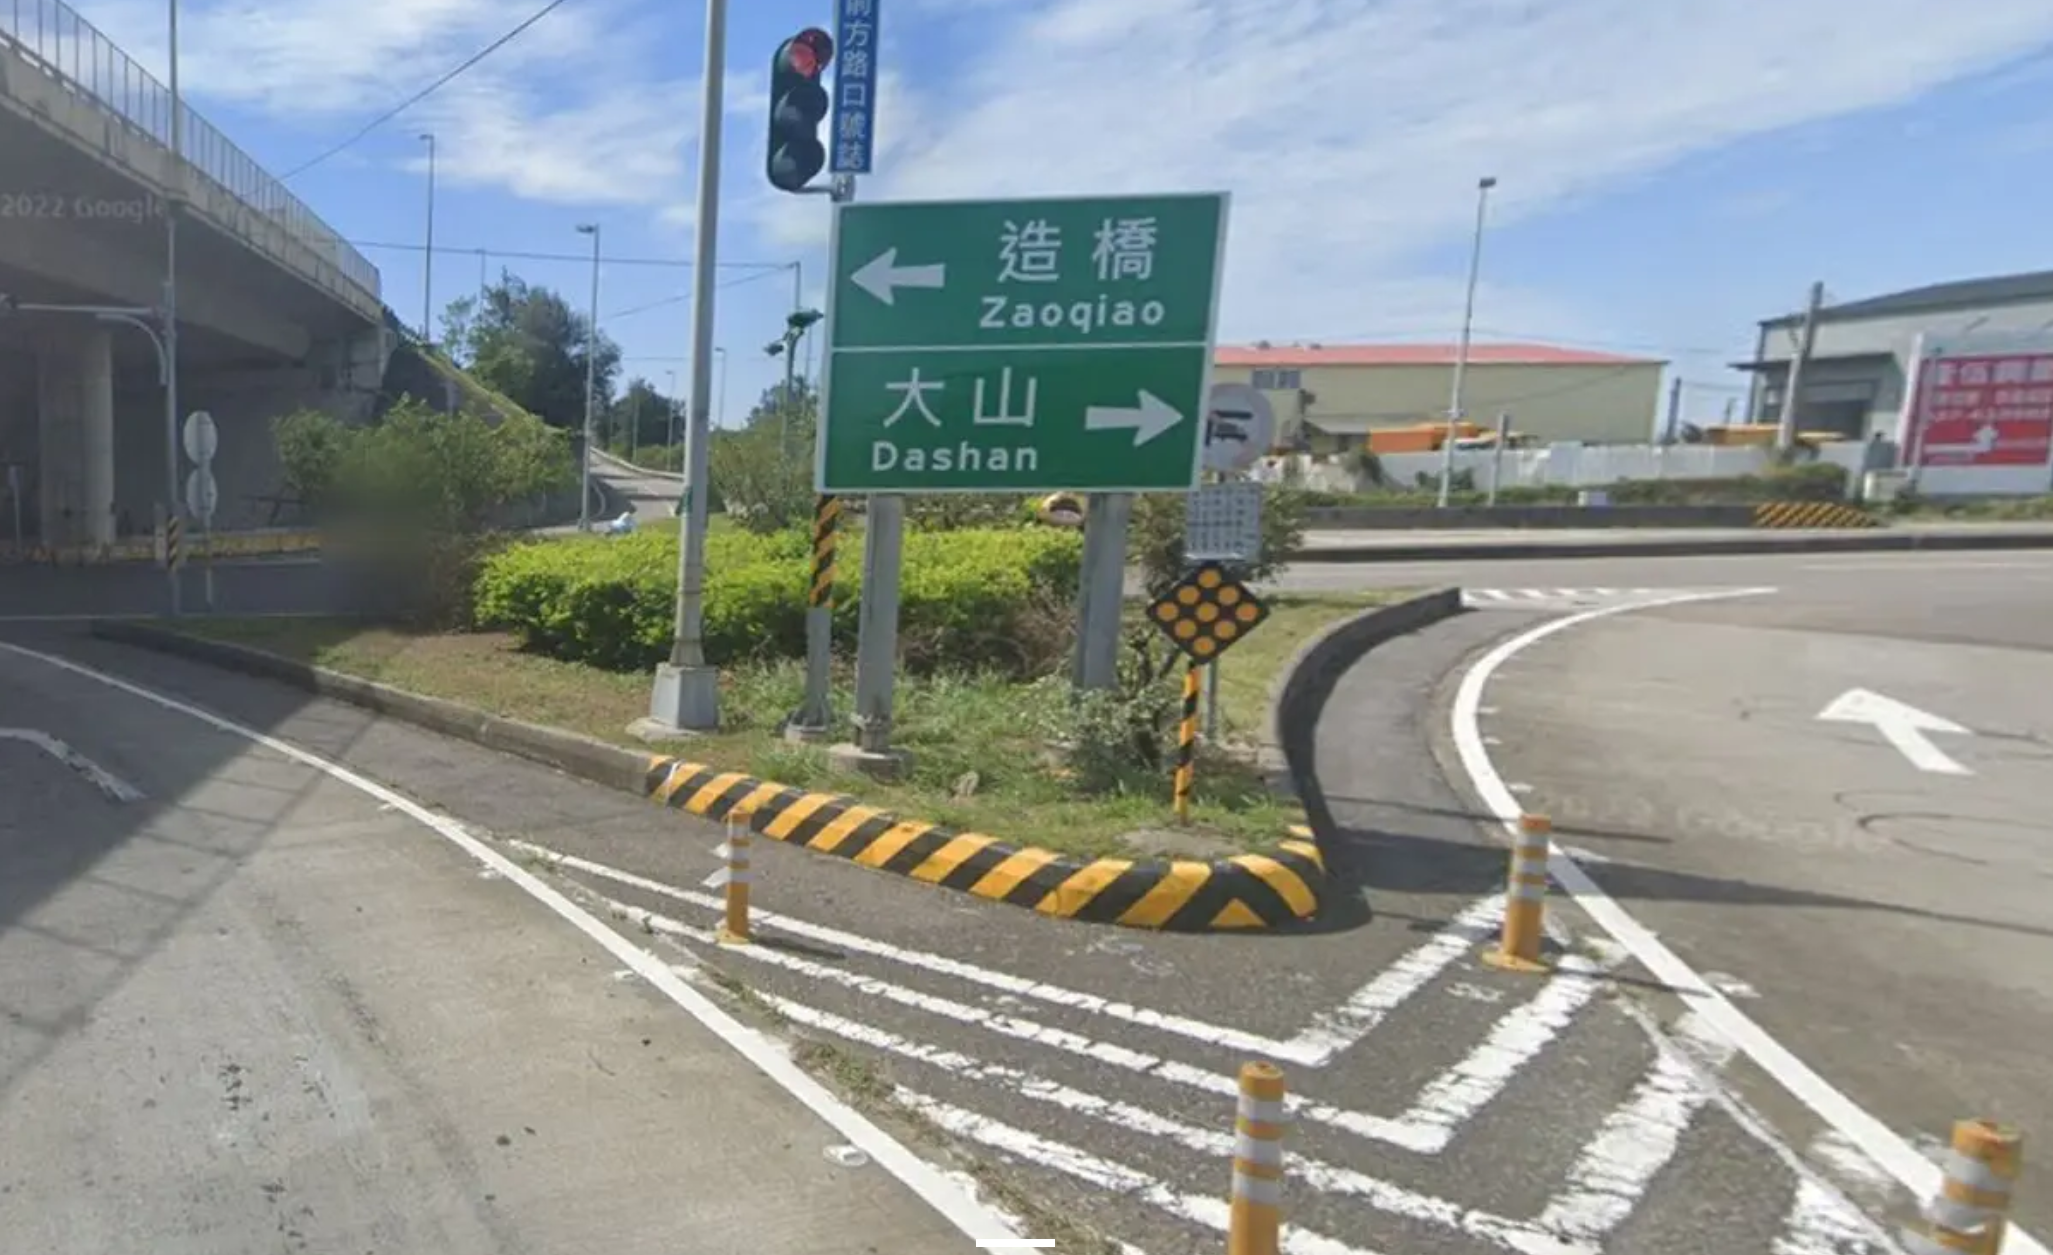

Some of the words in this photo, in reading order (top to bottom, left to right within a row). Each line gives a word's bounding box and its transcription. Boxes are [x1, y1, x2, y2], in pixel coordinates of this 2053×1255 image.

[997, 216, 1158, 283] 造橋
[979, 295, 1166, 334] Zaoqiao
[883, 366, 1038, 429] 大山
[871, 441, 1038, 472] Dashan
